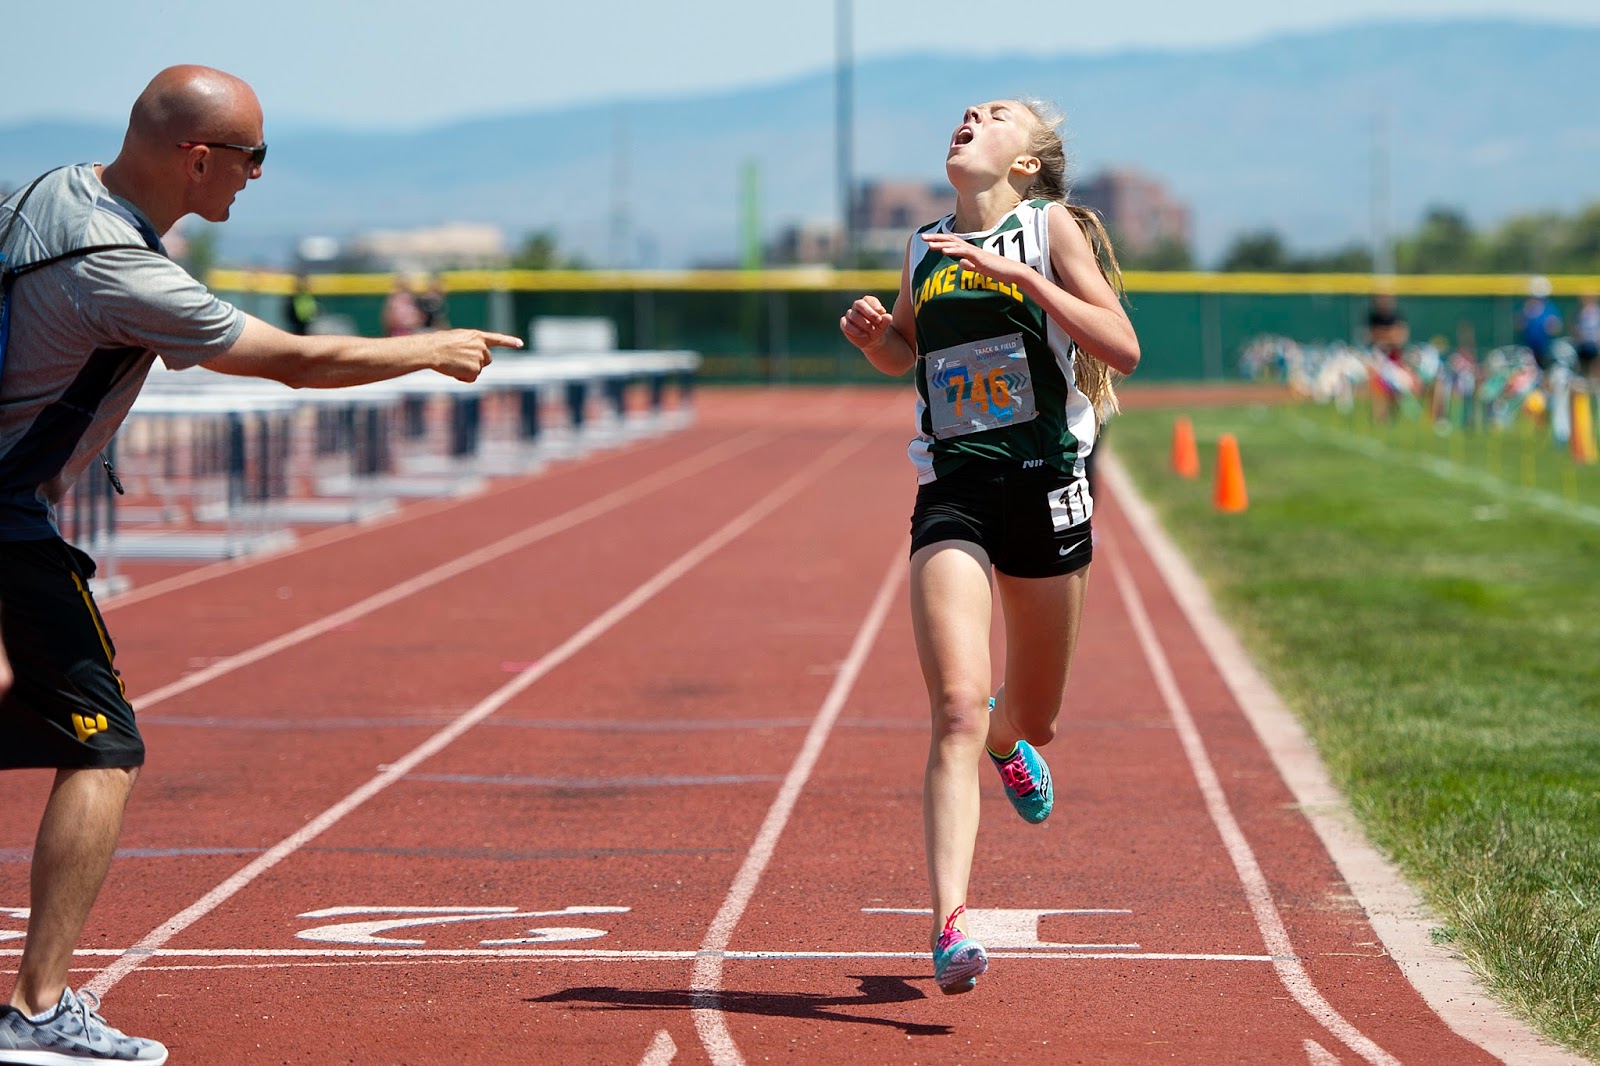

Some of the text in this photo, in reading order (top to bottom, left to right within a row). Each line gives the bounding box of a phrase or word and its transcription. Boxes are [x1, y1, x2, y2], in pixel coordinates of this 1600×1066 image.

[914, 264, 959, 318] LAKE
[974, 346, 994, 356] TRACK
[1000, 341, 1017, 351] FIELD
[948, 367, 1010, 418] 746
[1059, 482, 1087, 526] 11
